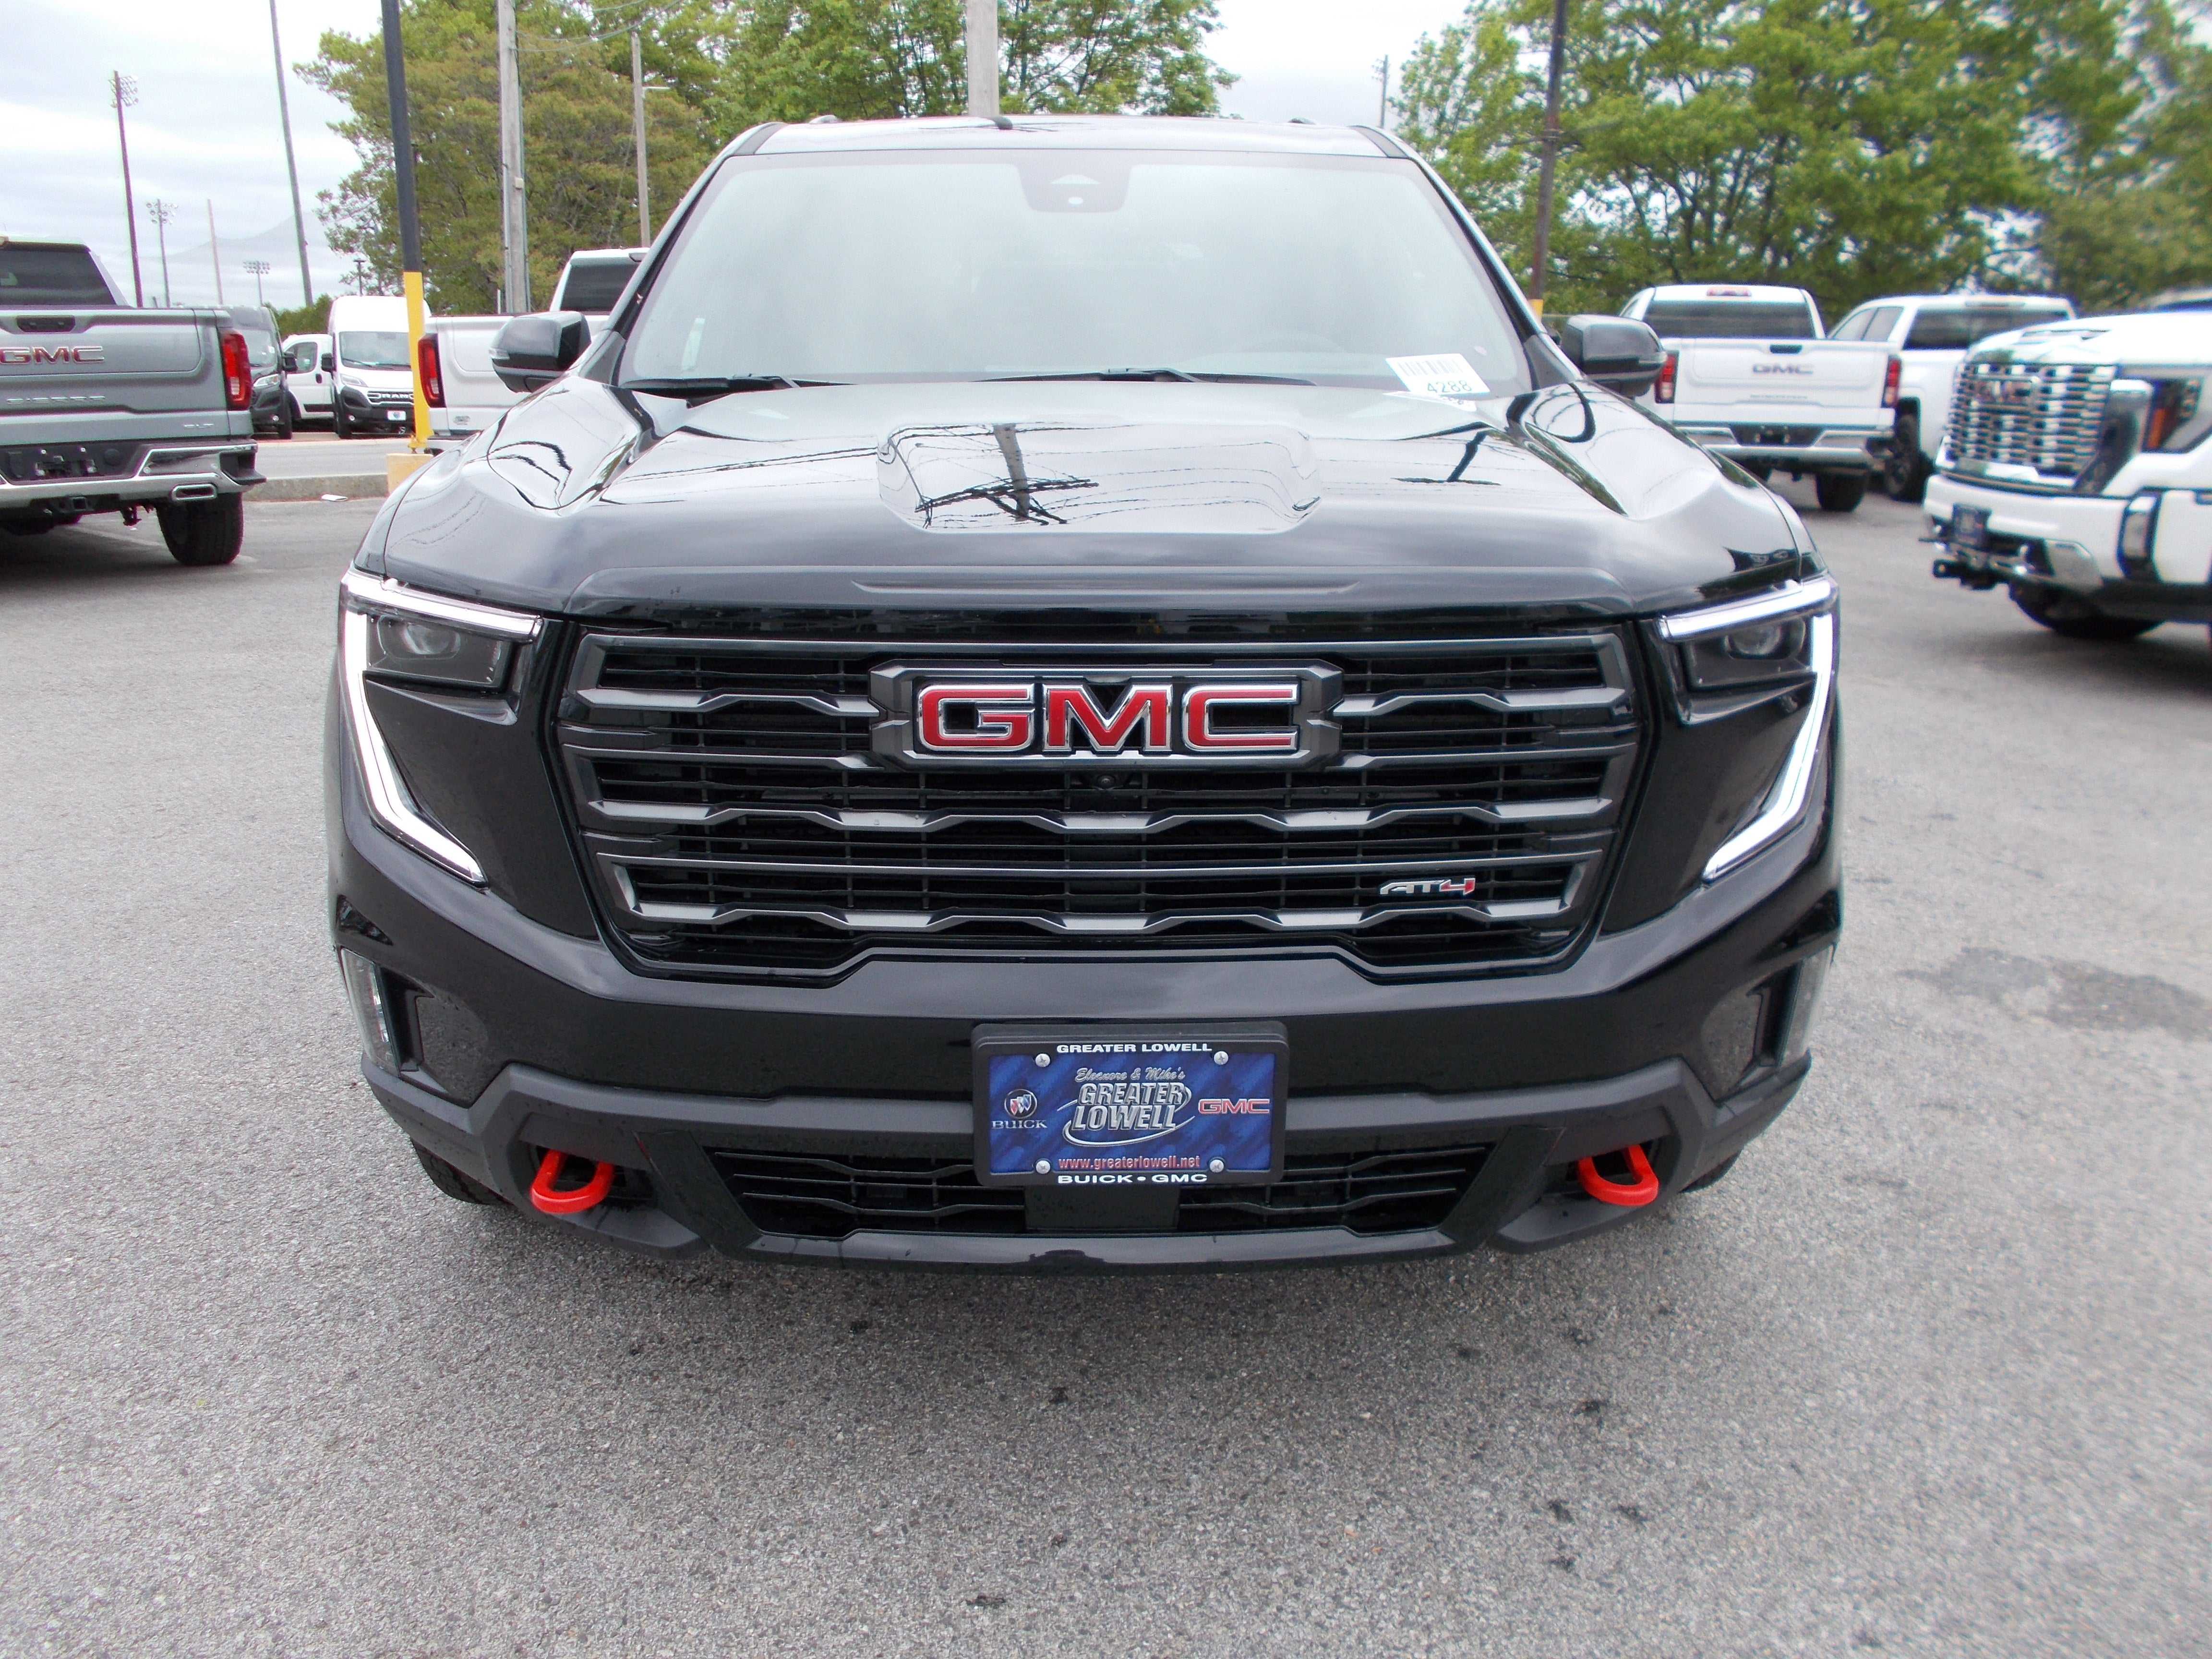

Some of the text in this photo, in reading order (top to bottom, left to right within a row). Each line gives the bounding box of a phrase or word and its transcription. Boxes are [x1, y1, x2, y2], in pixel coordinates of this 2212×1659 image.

[0, 346, 105, 365] GMC
[1427, 380, 1472, 393] 4288
[918, 684, 1299, 752] GMC
[1380, 878, 1476, 895] AT4
[1057, 1044, 1212, 1053] GREATER LOWELL
[1075, 1067, 1185, 1082] Eleanore & Mike's
[1078, 1082, 1185, 1106] GREATER
[1199, 1099, 1270, 1114] GMC
[991, 1120, 1047, 1129] BUICK
[1071, 1105, 1176, 1131] LOWELL
[1058, 1156, 1200, 1169] www.greaterlowell.net
[1058, 1174, 1207, 1183] BUICK GMC
